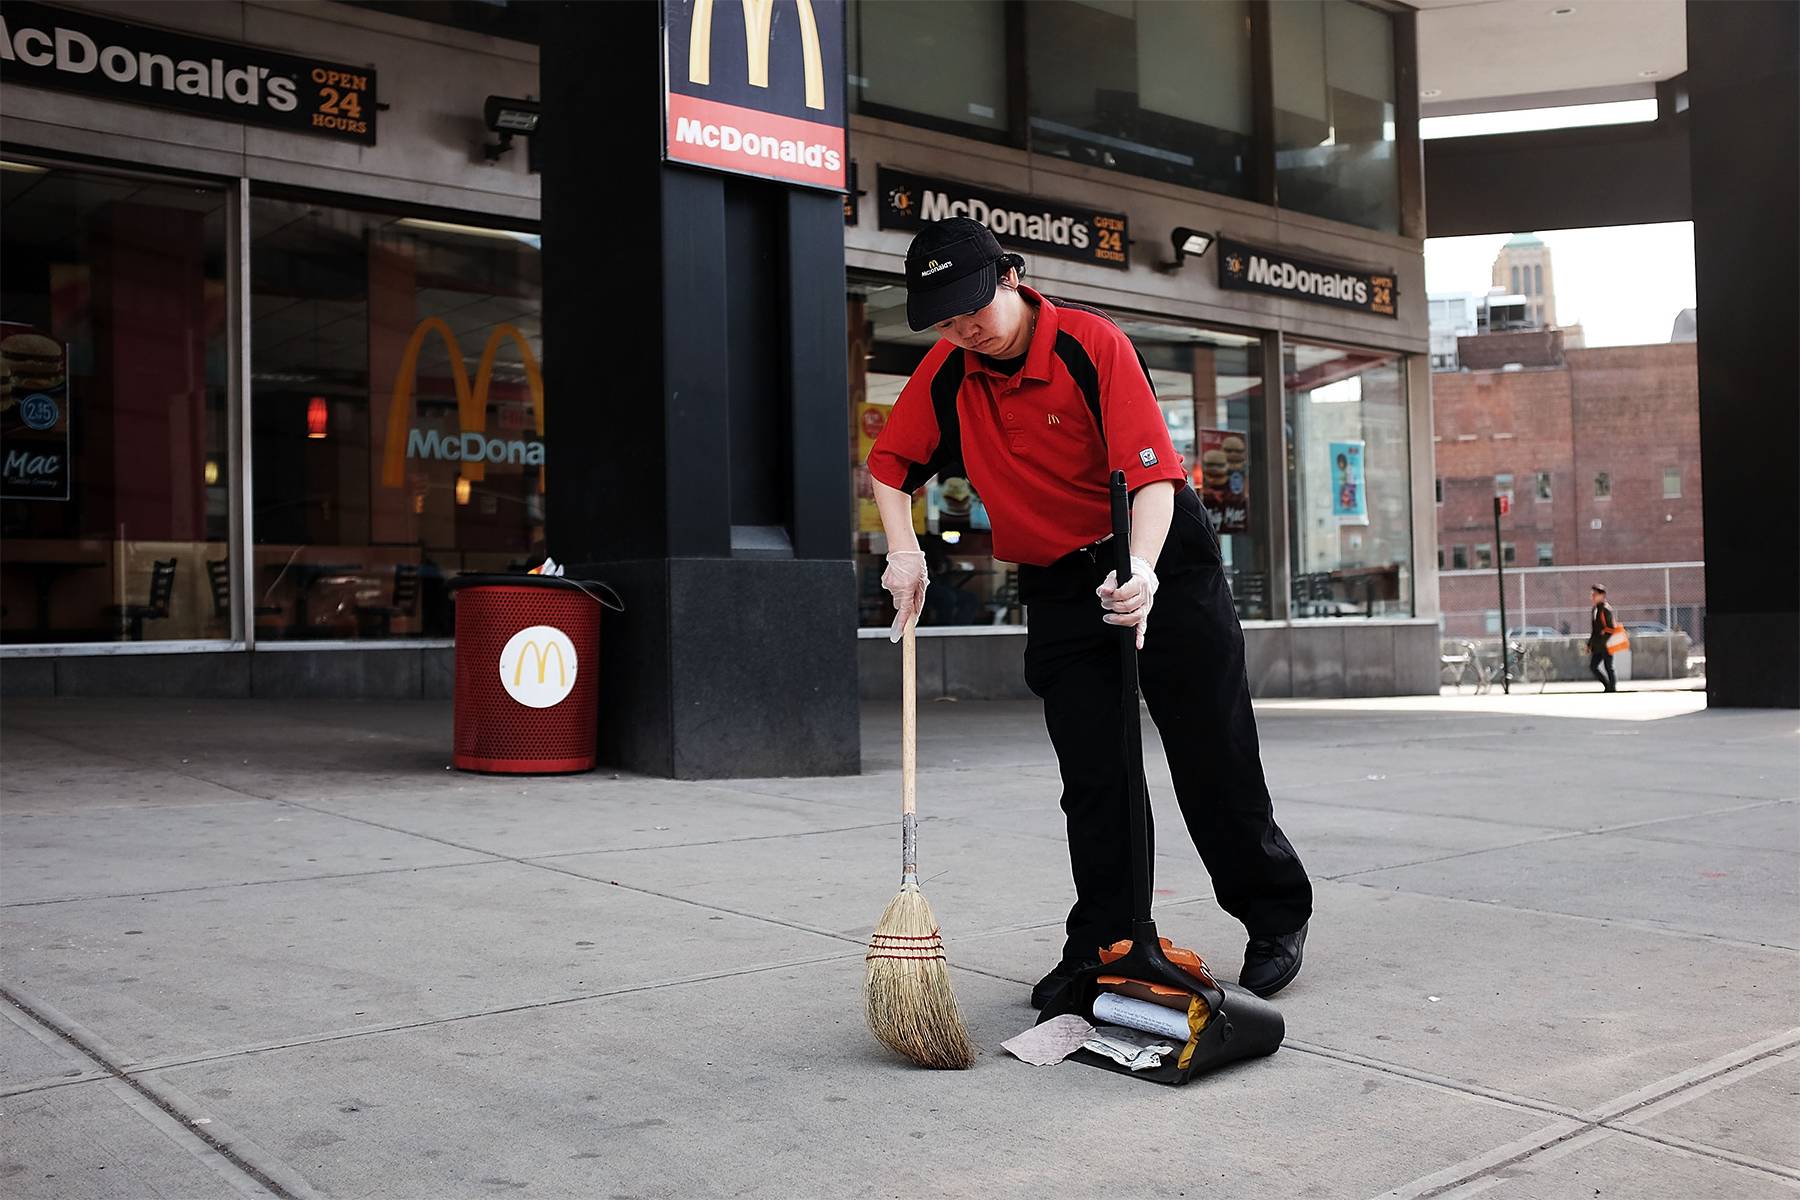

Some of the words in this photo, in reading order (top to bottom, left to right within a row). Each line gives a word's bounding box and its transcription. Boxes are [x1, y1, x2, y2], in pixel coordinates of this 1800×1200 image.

[312, 69, 367, 90] OPEN
[319, 87, 362, 118] 24
[312, 113, 367, 134] HOURS
[675, 117, 841, 171] McDonald's
[920, 190, 1089, 249] McDonald's
[1099, 229, 1121, 251] 24
[1247, 256, 1368, 304] McDonald's
[1373, 287, 1391, 304] 24
[3, 450, 60, 478] Mac
